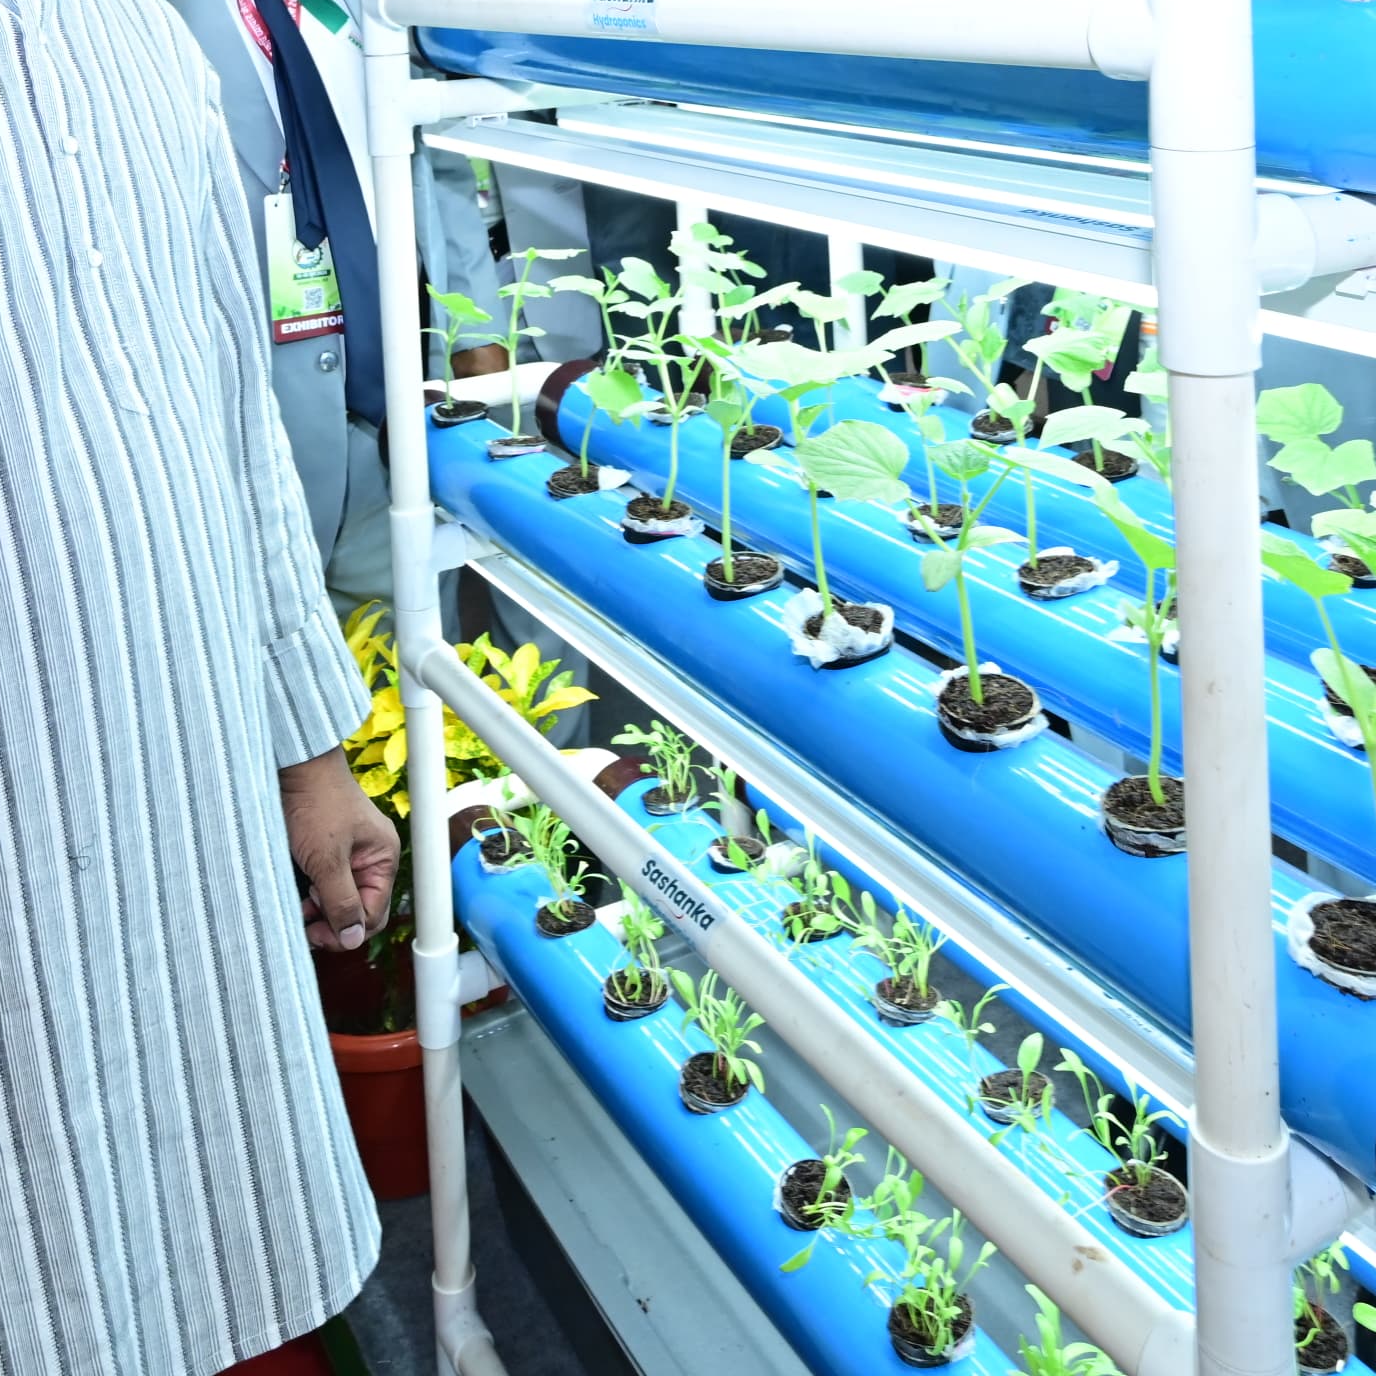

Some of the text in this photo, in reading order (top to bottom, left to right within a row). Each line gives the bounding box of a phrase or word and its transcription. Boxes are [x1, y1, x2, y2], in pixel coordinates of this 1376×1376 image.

[592, 14, 647, 30] Hydroponics
[280, 314, 344, 335] EXHIBITOR
[641, 859, 716, 931] Sashanka
